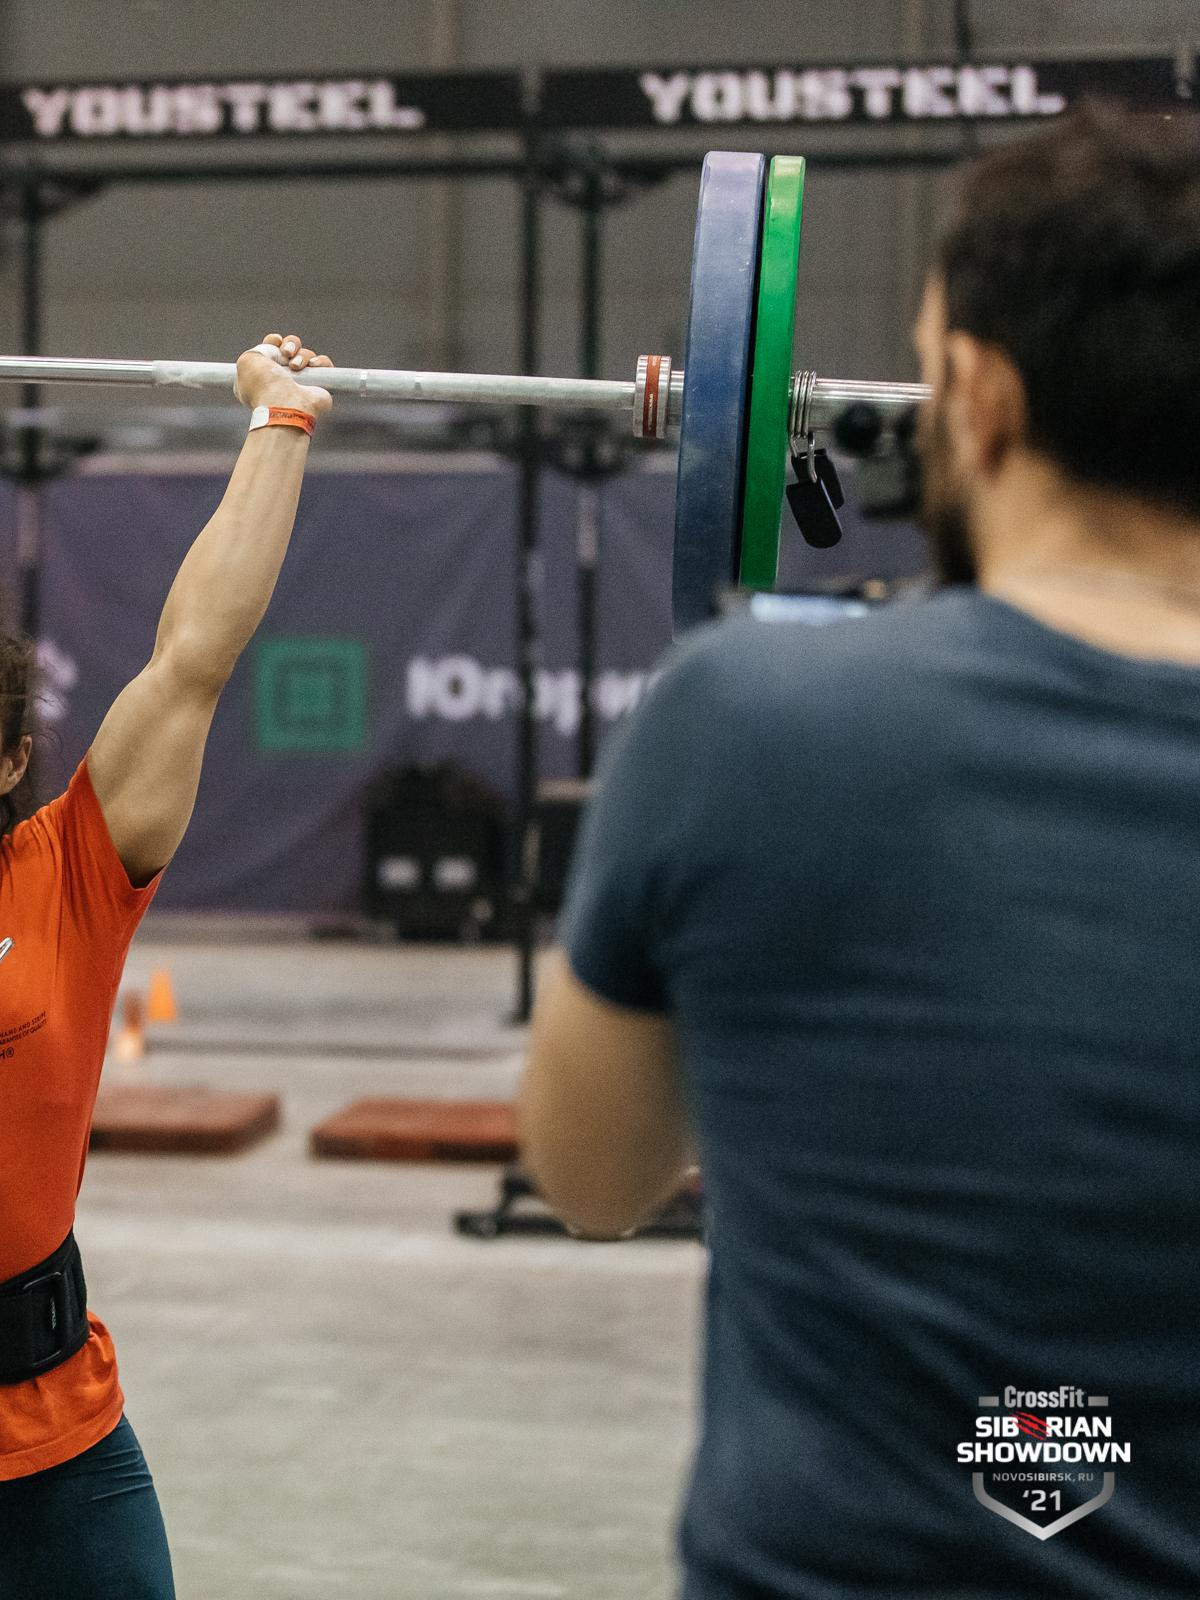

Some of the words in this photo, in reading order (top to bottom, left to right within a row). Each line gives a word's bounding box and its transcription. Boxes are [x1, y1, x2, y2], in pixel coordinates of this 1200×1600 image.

[22, 80, 425, 137] YOUSTEEL
[641, 66, 1066, 124] YOUSTEEL
[18, 1021, 31, 1031] AND
